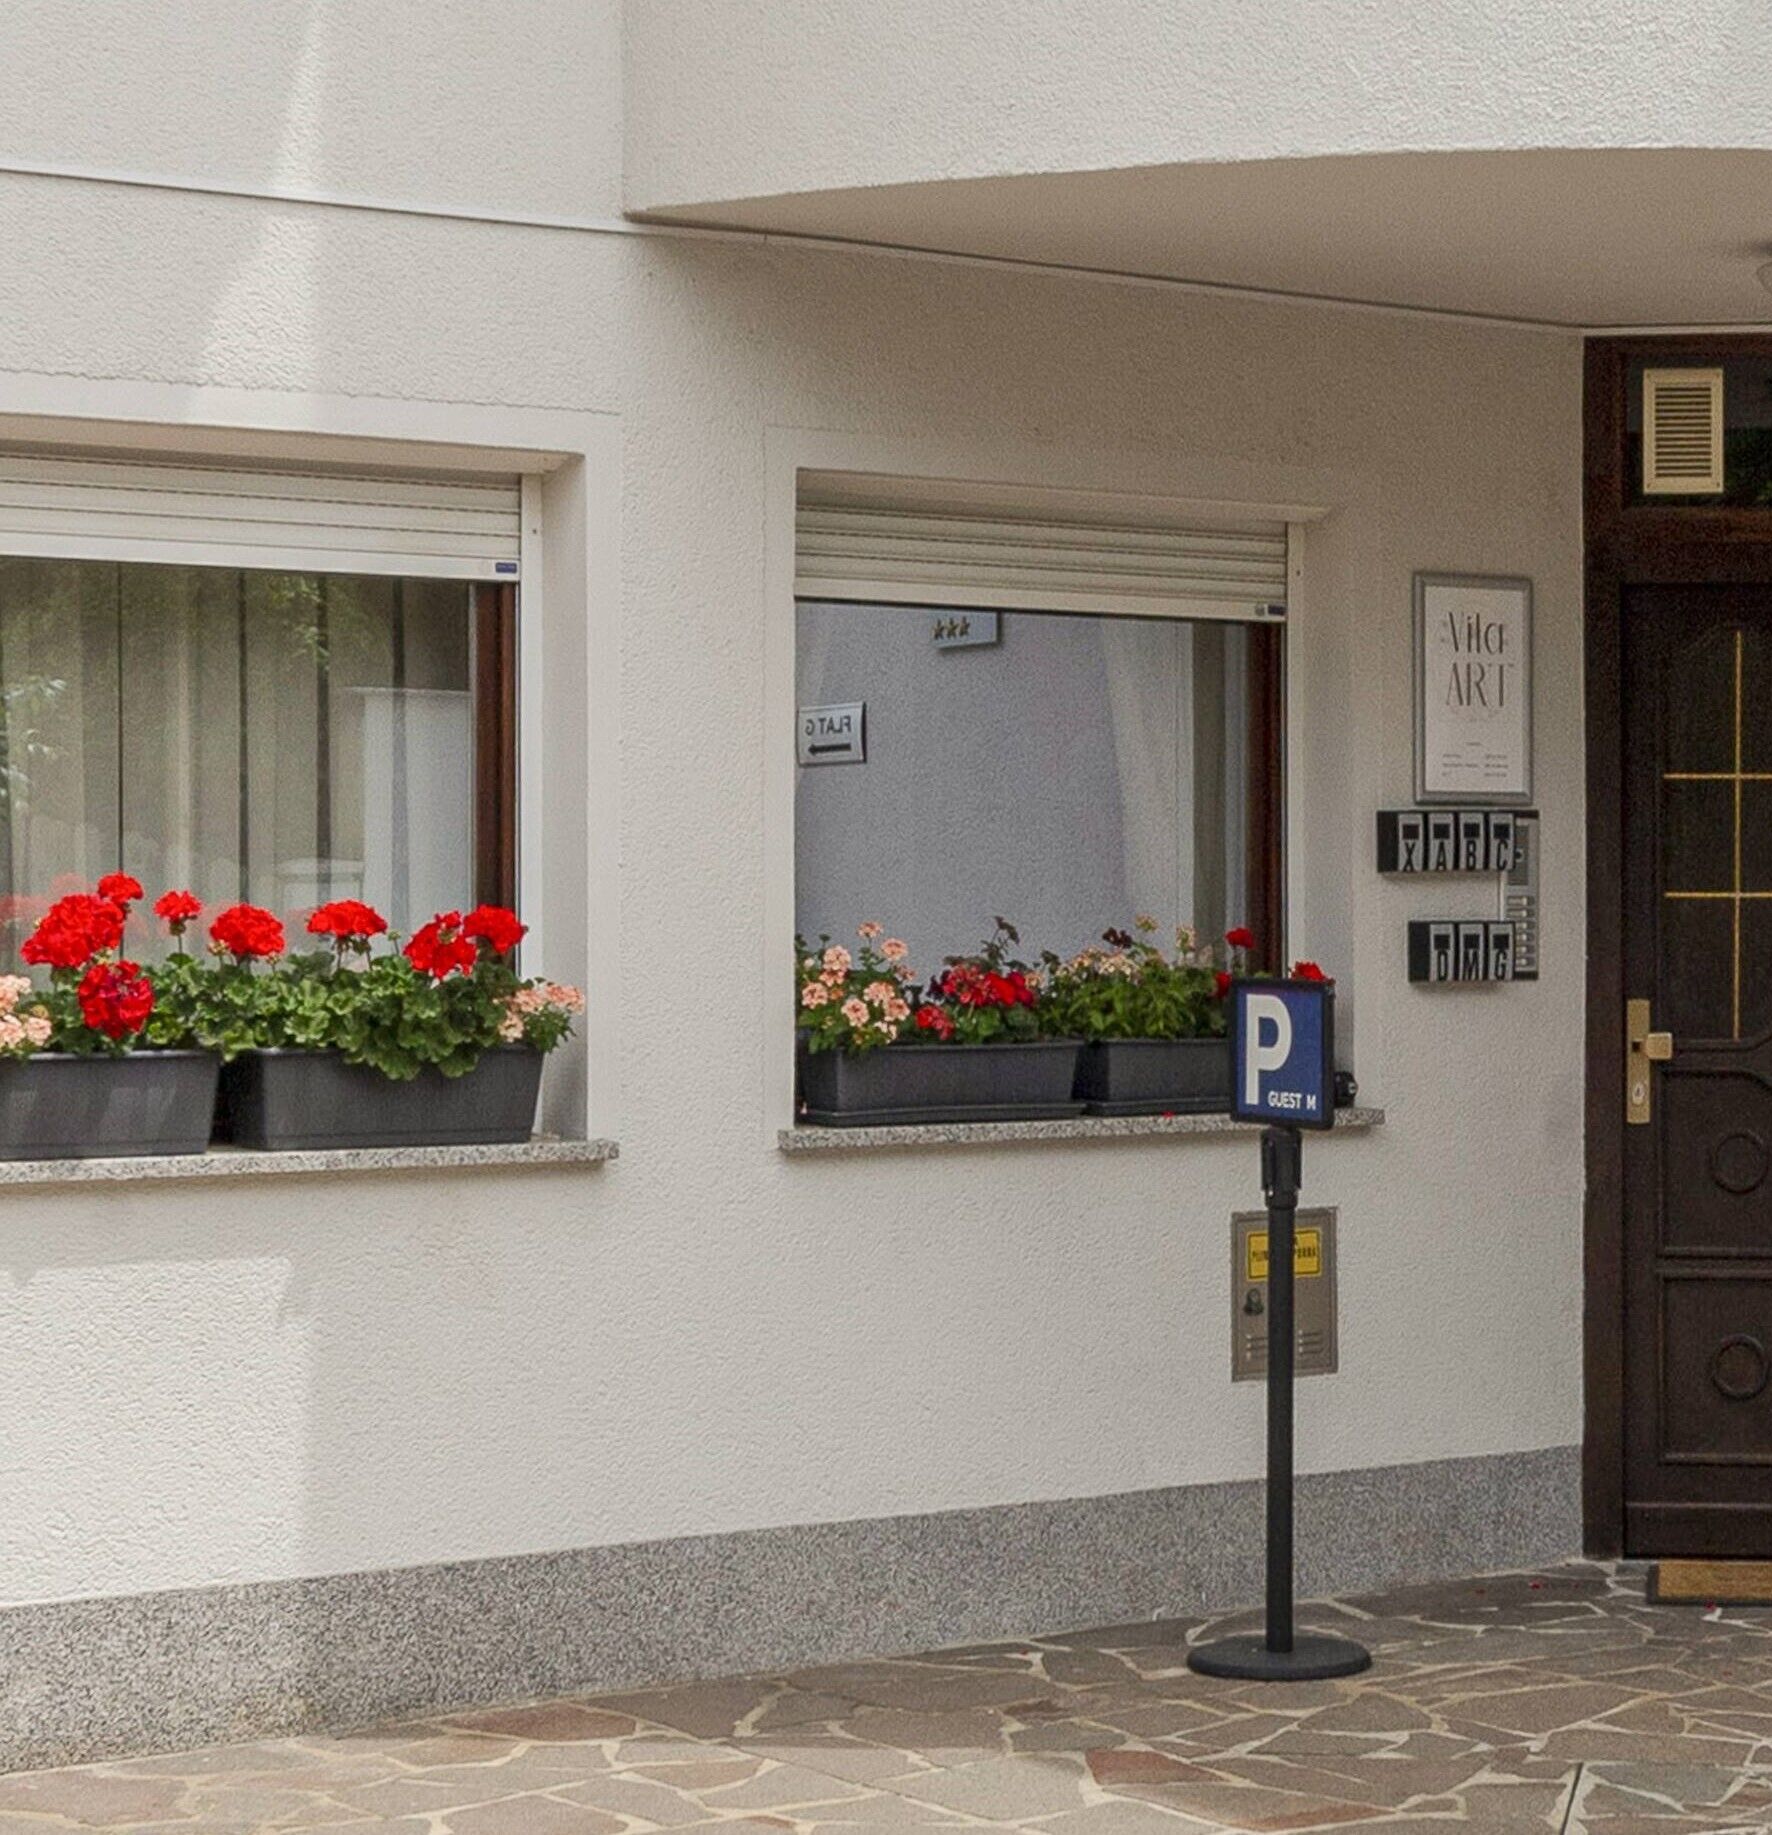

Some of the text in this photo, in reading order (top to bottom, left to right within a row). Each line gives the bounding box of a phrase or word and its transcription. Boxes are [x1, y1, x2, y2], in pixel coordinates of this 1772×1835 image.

[1448, 612, 1504, 654] Vila
[1446, 661, 1514, 707] ART
[1403, 840, 1508, 873] X A B C
[1463, 950, 1479, 981] M
[1496, 949, 1508, 980] G
[1245, 993, 1293, 1106] P
[1267, 1090, 1317, 1111] GUEST M
